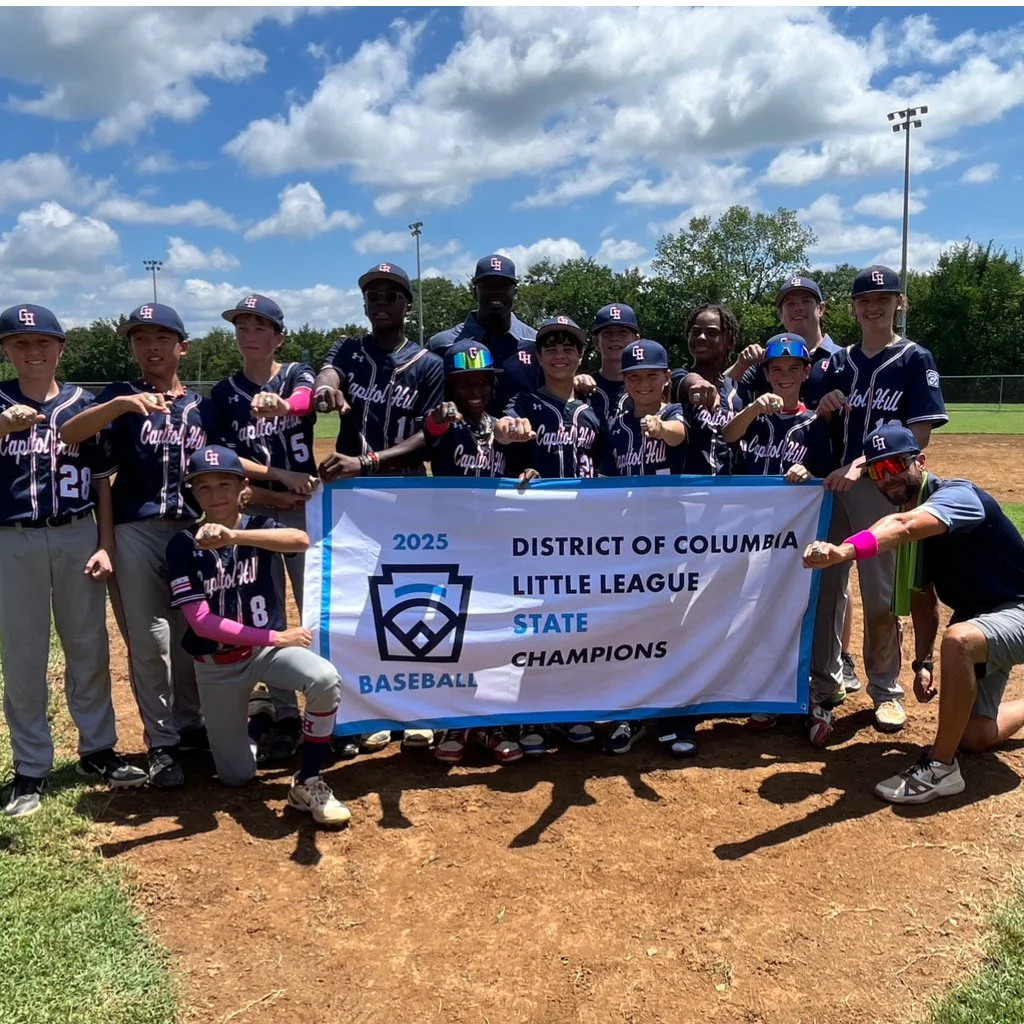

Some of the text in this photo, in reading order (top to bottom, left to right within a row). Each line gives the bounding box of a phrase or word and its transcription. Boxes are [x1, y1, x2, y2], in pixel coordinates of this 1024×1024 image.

[19, 309, 36, 326] CH
[347, 372, 390, 404] Capitol
[871, 387, 904, 412] Hill
[0, 429, 50, 464] Capitol
[140, 420, 183, 452] Capitol
[290, 433, 310, 463] 5
[536, 424, 575, 453] Capitol
[872, 435, 886, 450] CH
[205, 449, 220, 466] CH
[454, 444, 492, 475] Capitol
[645, 439, 667, 464] Hill
[747, 435, 808, 465] Capitol Hill
[59, 465, 92, 500] 28
[393, 533, 448, 551] 2025
[513, 531, 798, 557] DISTRICT OF COLUMBIA
[197, 556, 258, 599] Capitol Hill
[513, 572, 699, 595] LITTLE LEAGUE
[250, 595, 268, 627] 8
[513, 612, 588, 634] STATE
[511, 641, 667, 668] CHAMPIONS
[358, 672, 478, 695] BASEBALL
